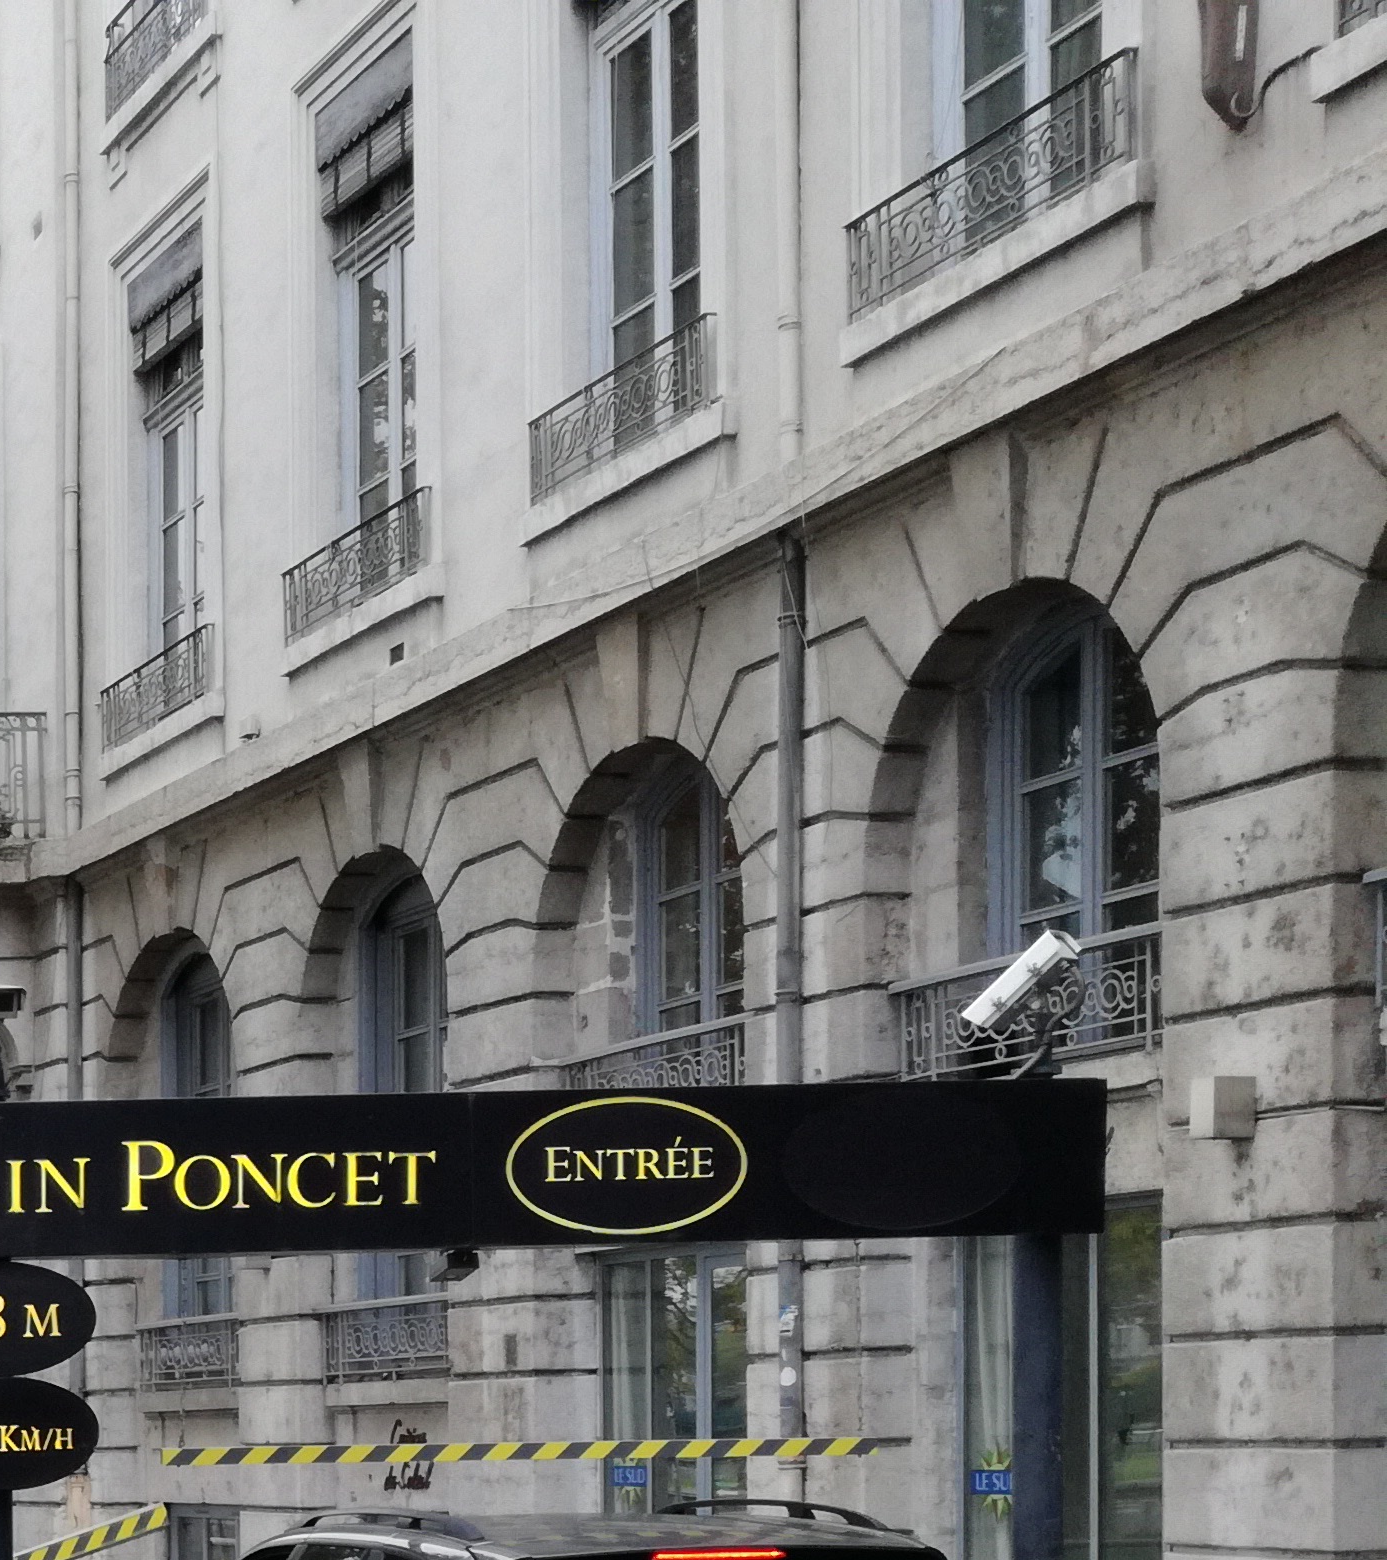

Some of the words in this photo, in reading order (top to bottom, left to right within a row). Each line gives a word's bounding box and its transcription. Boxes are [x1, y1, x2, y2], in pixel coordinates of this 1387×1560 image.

[121, 1140, 437, 1211] PONCET
[544, 1136, 715, 1182] ENTRÉE
[975, 1472, 989, 1491] LE
[992, 1472, 1013, 1491] SU
